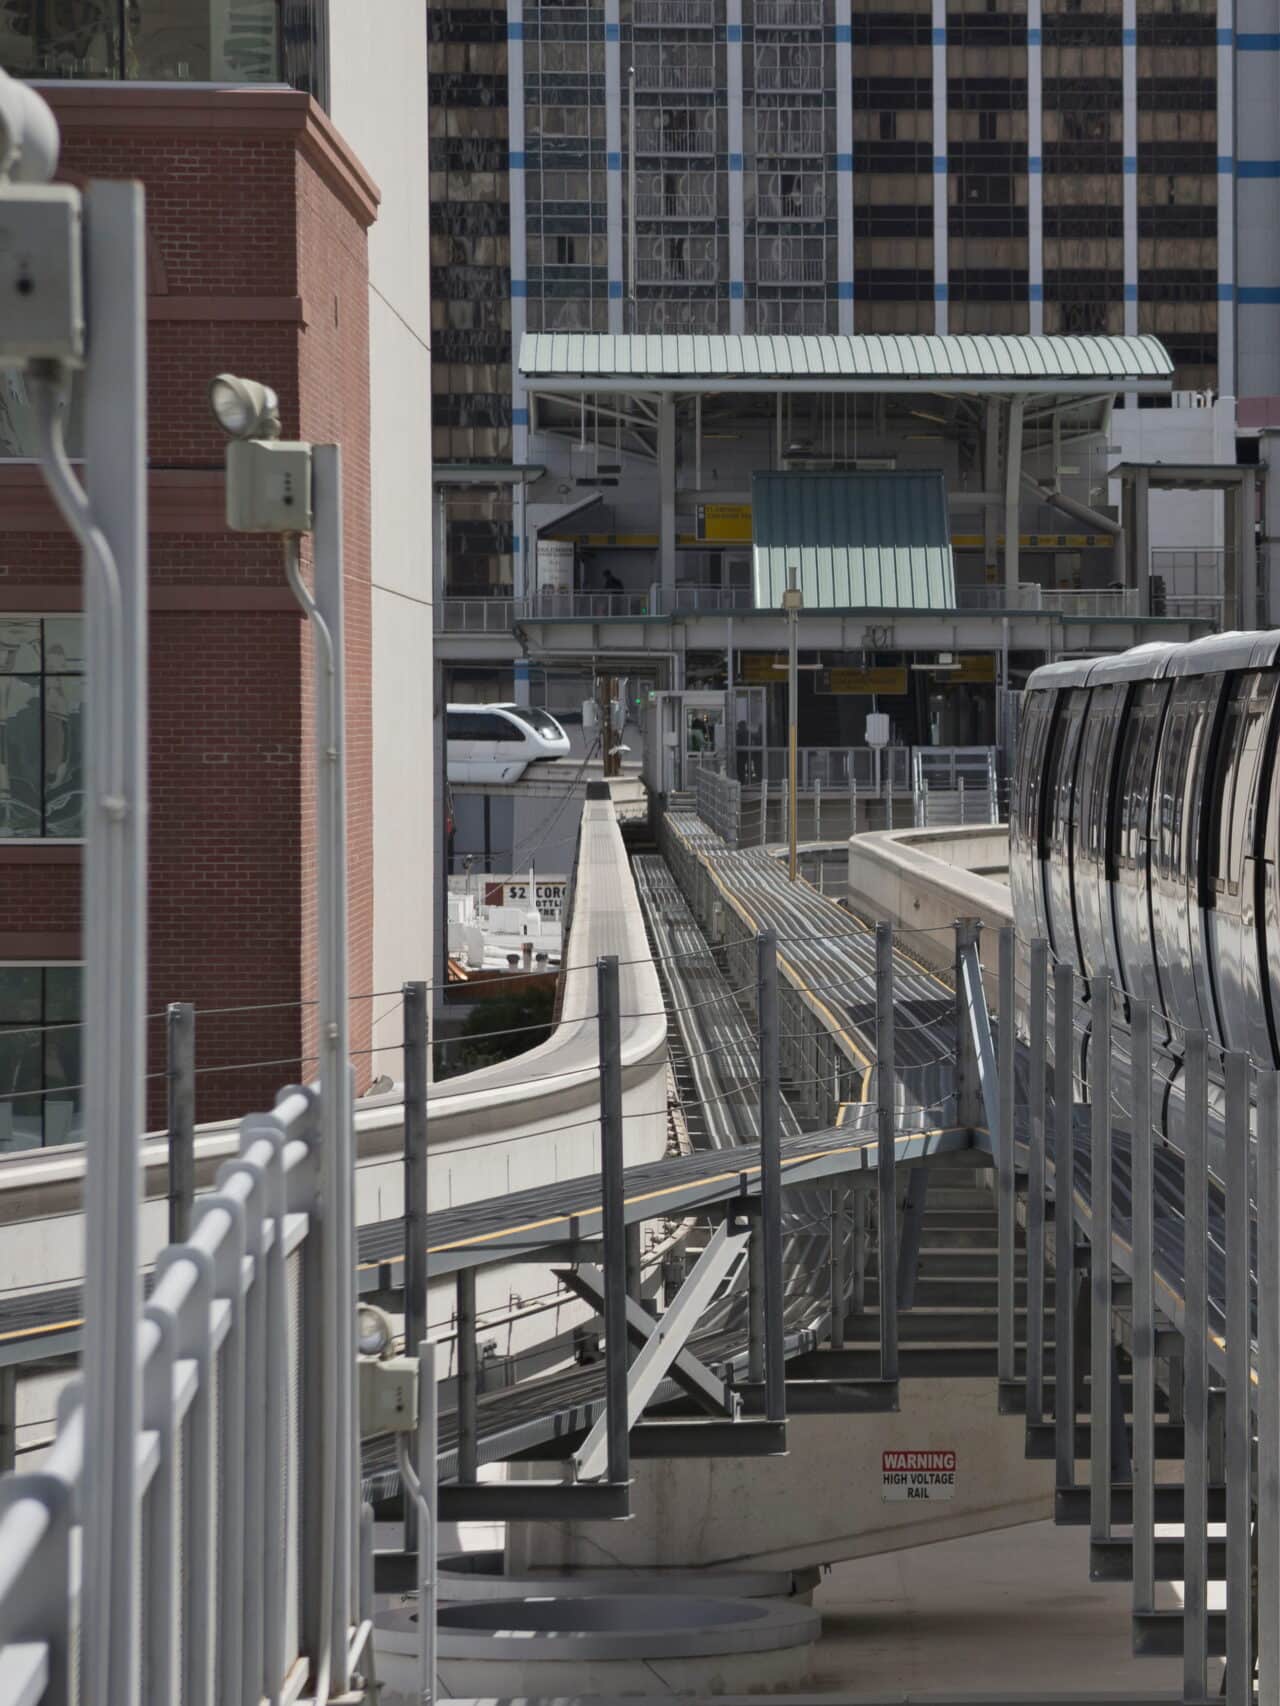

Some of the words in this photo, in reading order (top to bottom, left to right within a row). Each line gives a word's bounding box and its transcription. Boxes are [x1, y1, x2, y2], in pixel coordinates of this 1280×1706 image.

[510, 887, 526, 899] $2
[883, 1453, 955, 1470] WARNING
[882, 1473, 908, 1485] HIGH
[910, 1473, 955, 1485] VOLTAGE
[906, 1487, 930, 1499] RAIL
